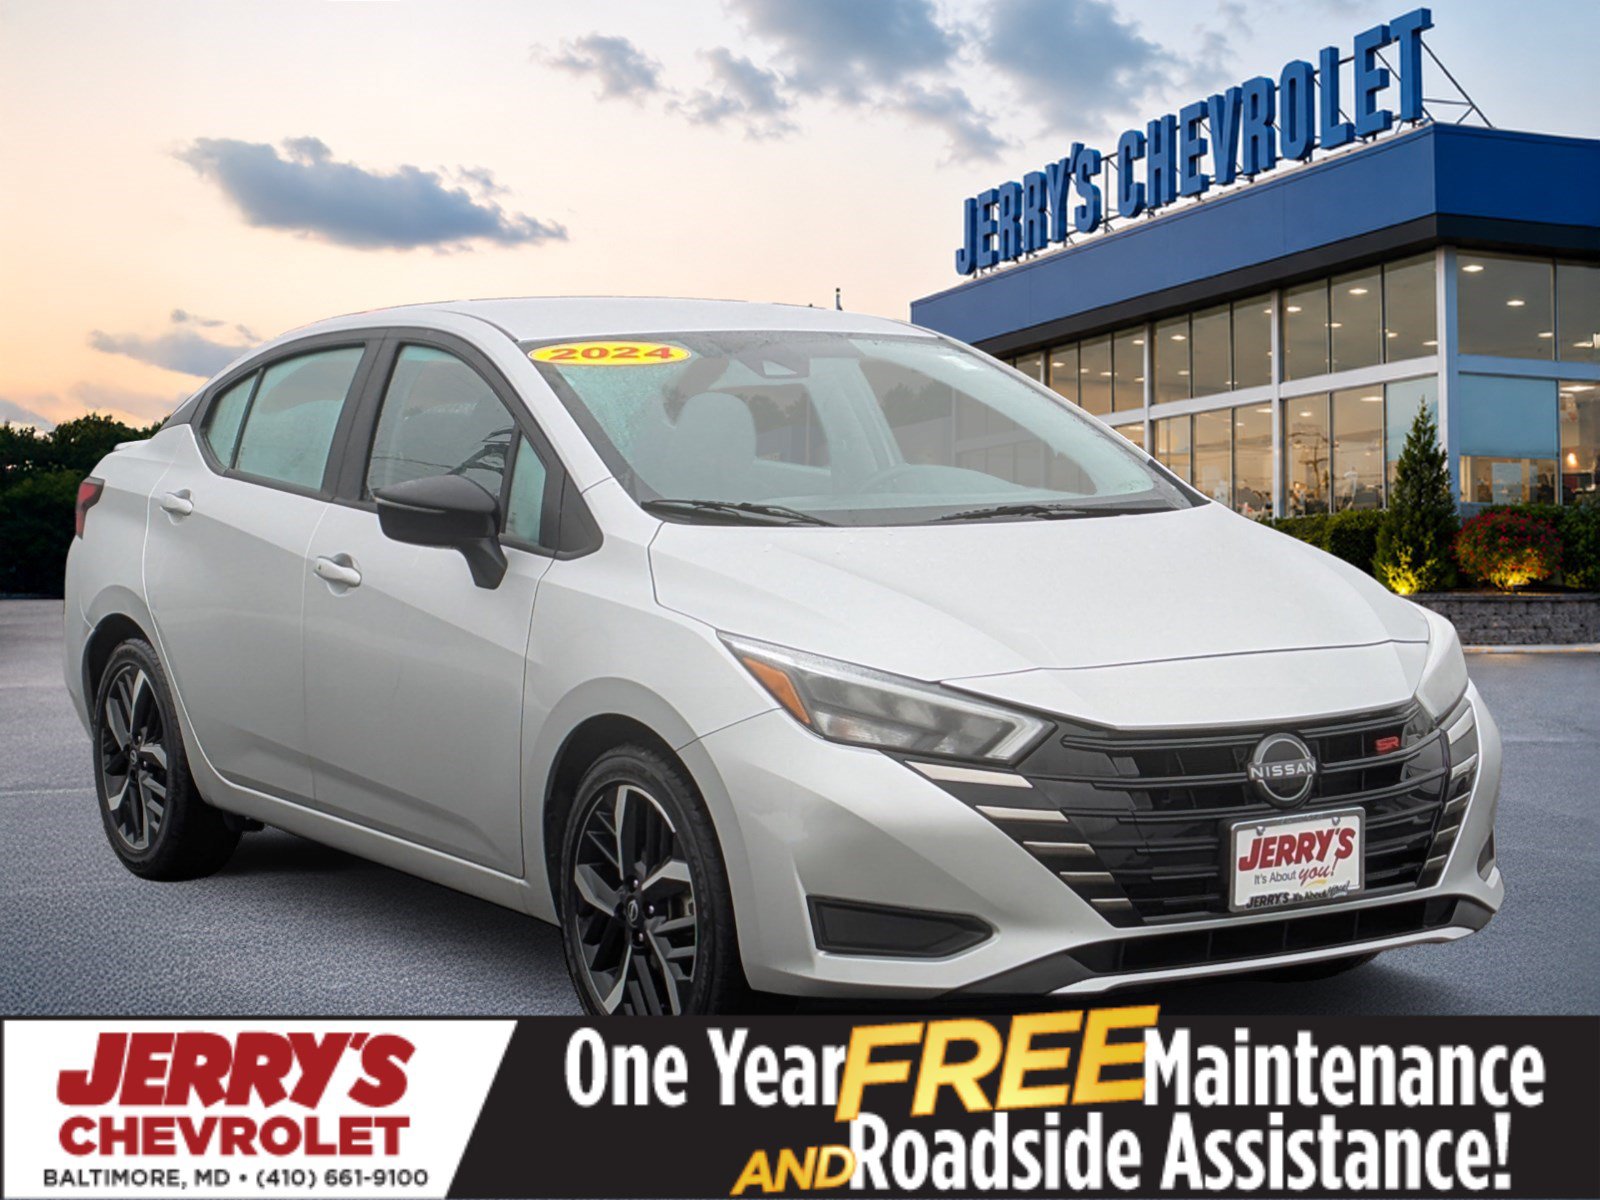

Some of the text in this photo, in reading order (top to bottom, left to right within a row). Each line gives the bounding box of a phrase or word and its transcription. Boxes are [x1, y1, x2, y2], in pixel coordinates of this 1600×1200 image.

[956, 8, 1433, 275] JERRY'S CHEVROLET
[549, 346, 673, 360] 2024
[1375, 736, 1399, 754] SR
[1250, 761, 1317, 778] NISSAN
[1238, 827, 1356, 871] JERRY'S
[1254, 857, 1339, 887] It's About you!
[1246, 892, 1290, 909] JERRY'S
